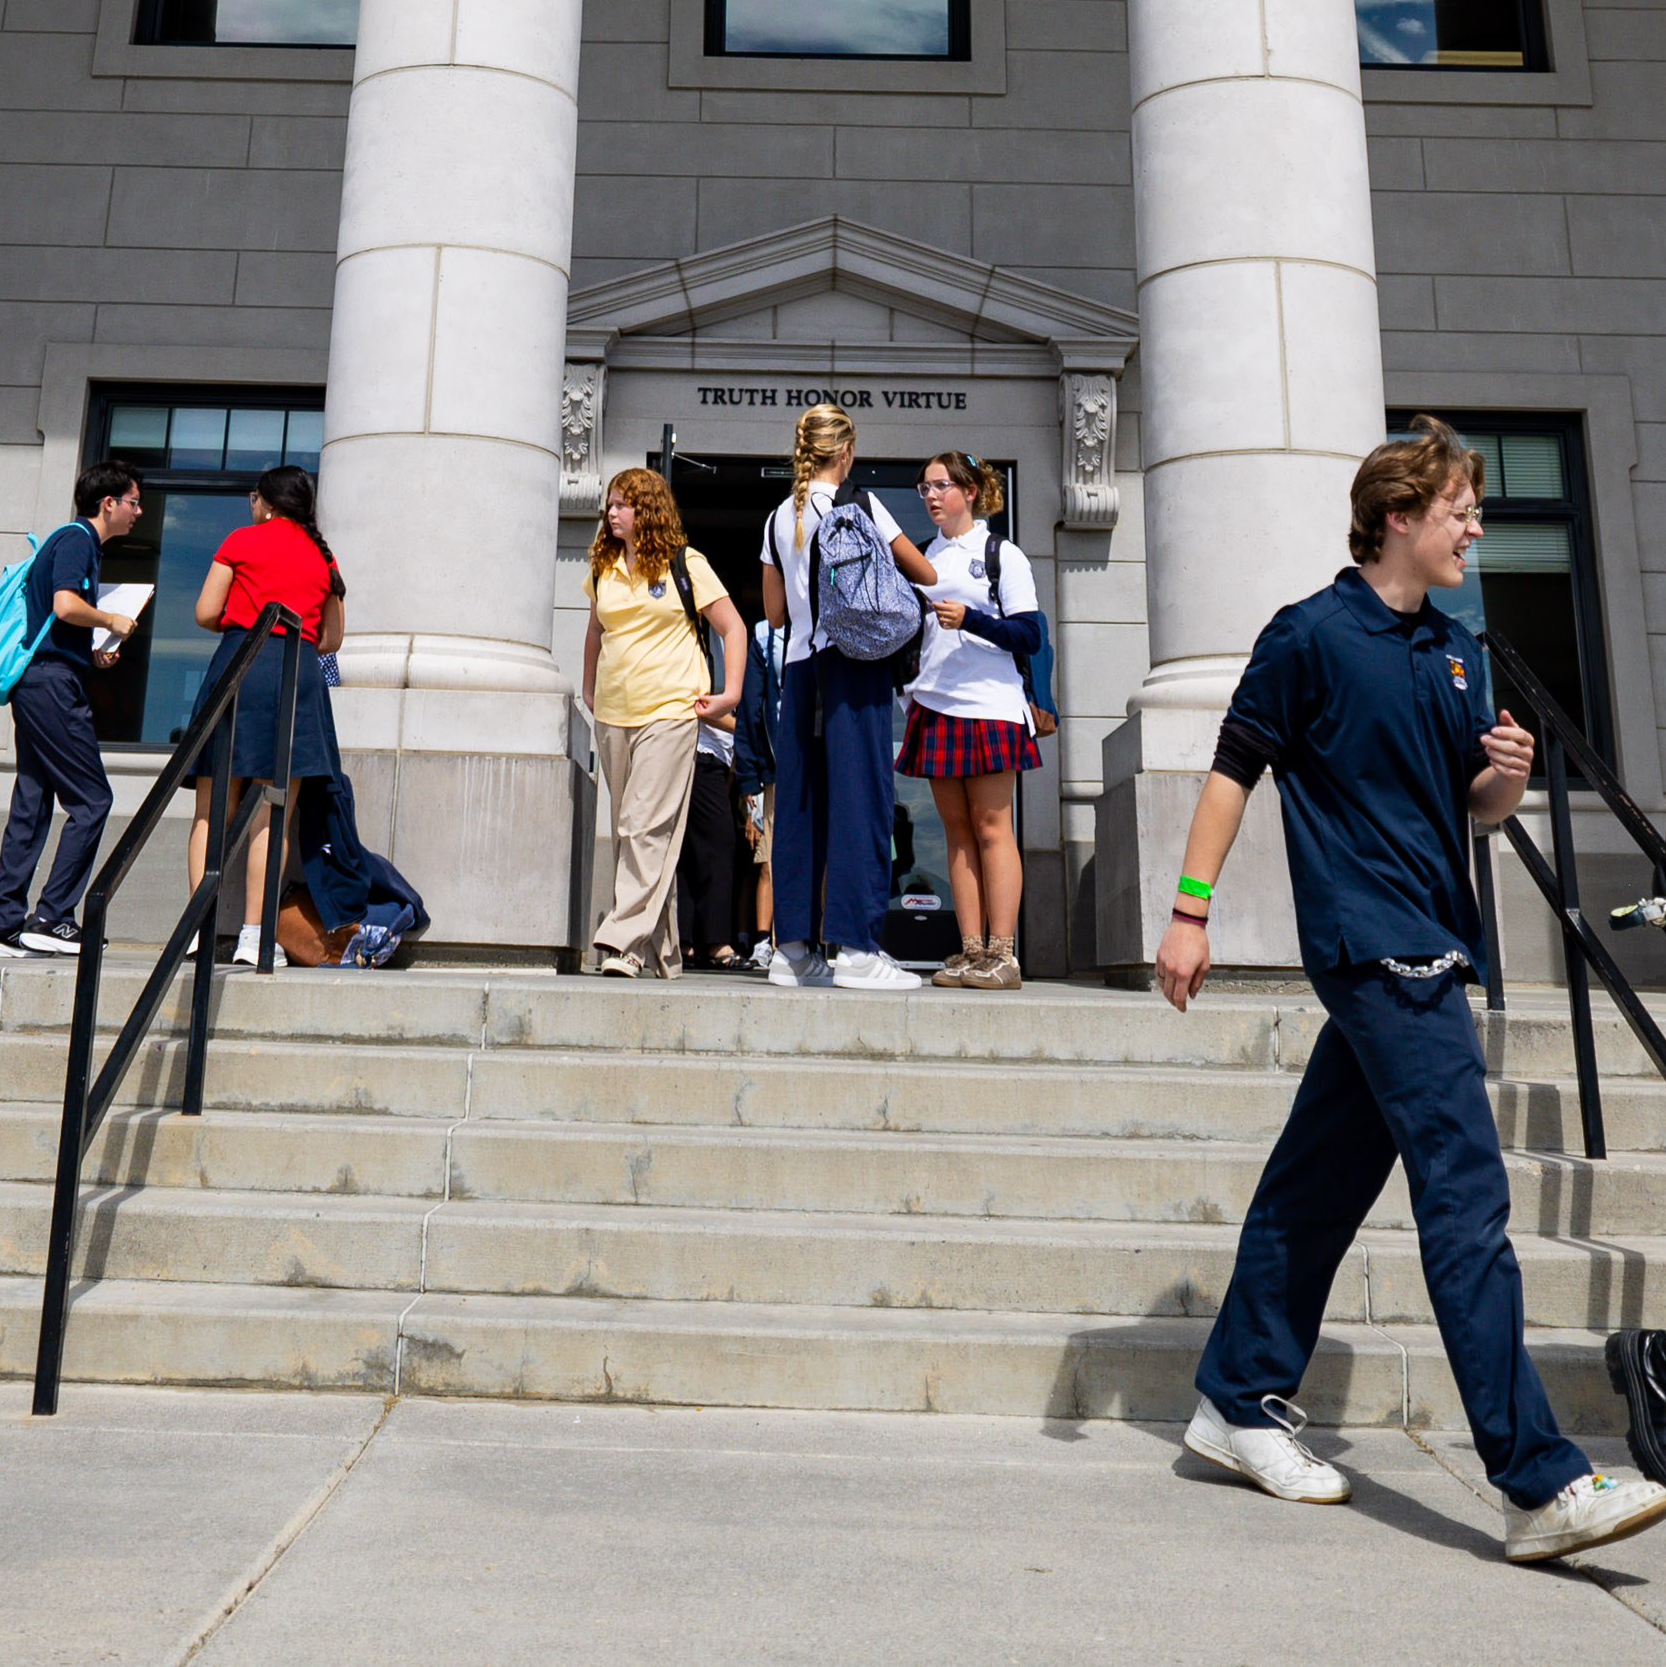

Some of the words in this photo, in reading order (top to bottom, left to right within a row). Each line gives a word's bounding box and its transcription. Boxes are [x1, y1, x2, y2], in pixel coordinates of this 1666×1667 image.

[697, 387, 778, 407] TRUTH
[785, 389, 873, 408] HONOR
[881, 390, 967, 410] VIRTUE
